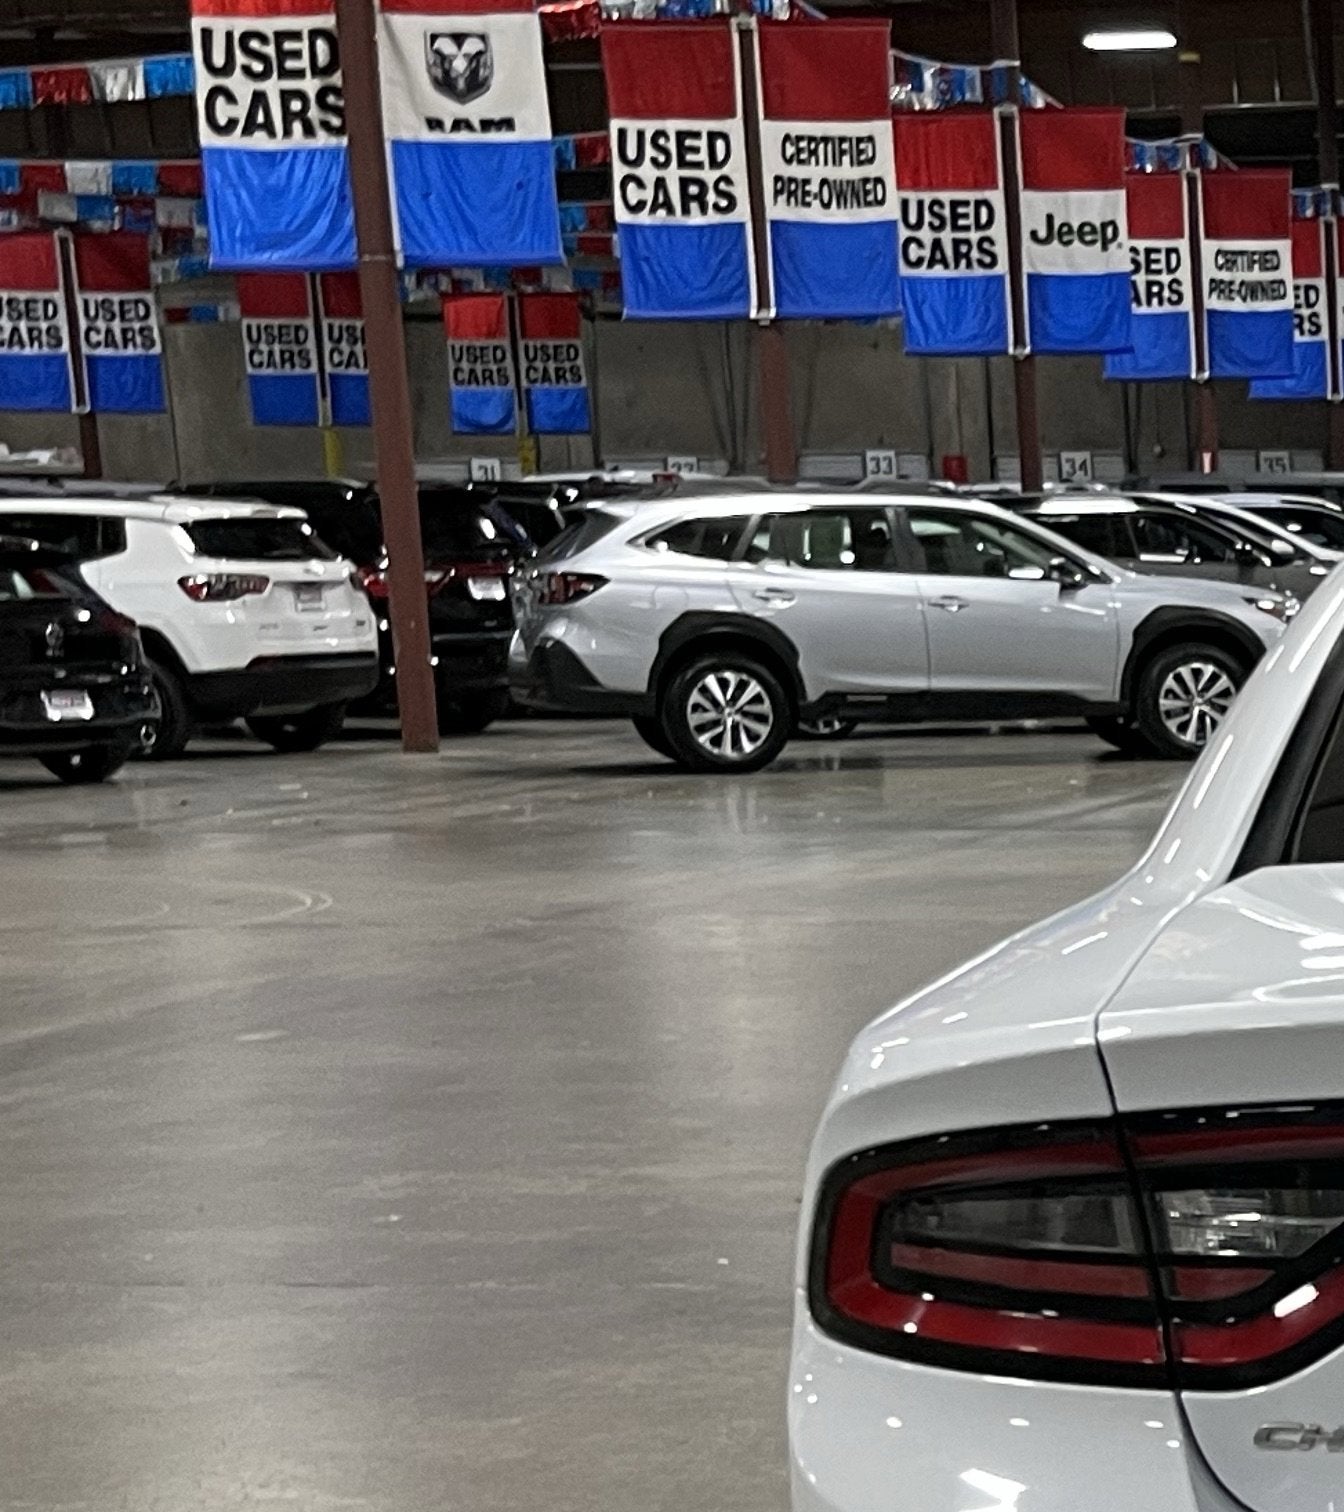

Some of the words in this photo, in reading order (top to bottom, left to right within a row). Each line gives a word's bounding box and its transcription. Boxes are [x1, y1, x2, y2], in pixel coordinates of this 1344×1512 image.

[200, 28, 339, 80] USED
[204, 85, 344, 138] CARS
[425, 117, 515, 132] RAM
[617, 128, 731, 170] USED
[781, 133, 875, 167] CERTIFIED
[619, 173, 737, 216] CARS
[773, 175, 887, 210] PRE-OWNED
[901, 198, 995, 233] USED
[1030, 213, 1120, 252] Jeep
[902, 236, 998, 270] CARS
[1129, 246, 1181, 275] SED
[1293, 284, 1320, 309] ED
[0, 297, 58, 322] SED
[83, 298, 150, 322] USED
[84, 325, 156, 350] CARS
[247, 323, 309, 345] USED
[327, 323, 366, 346] US
[249, 348, 311, 369] CARS
[524, 344, 579, 363] USED
[525, 365, 582, 384] CARS
[869, 455, 894, 475] 33
[1064, 457, 1089, 477] 34
